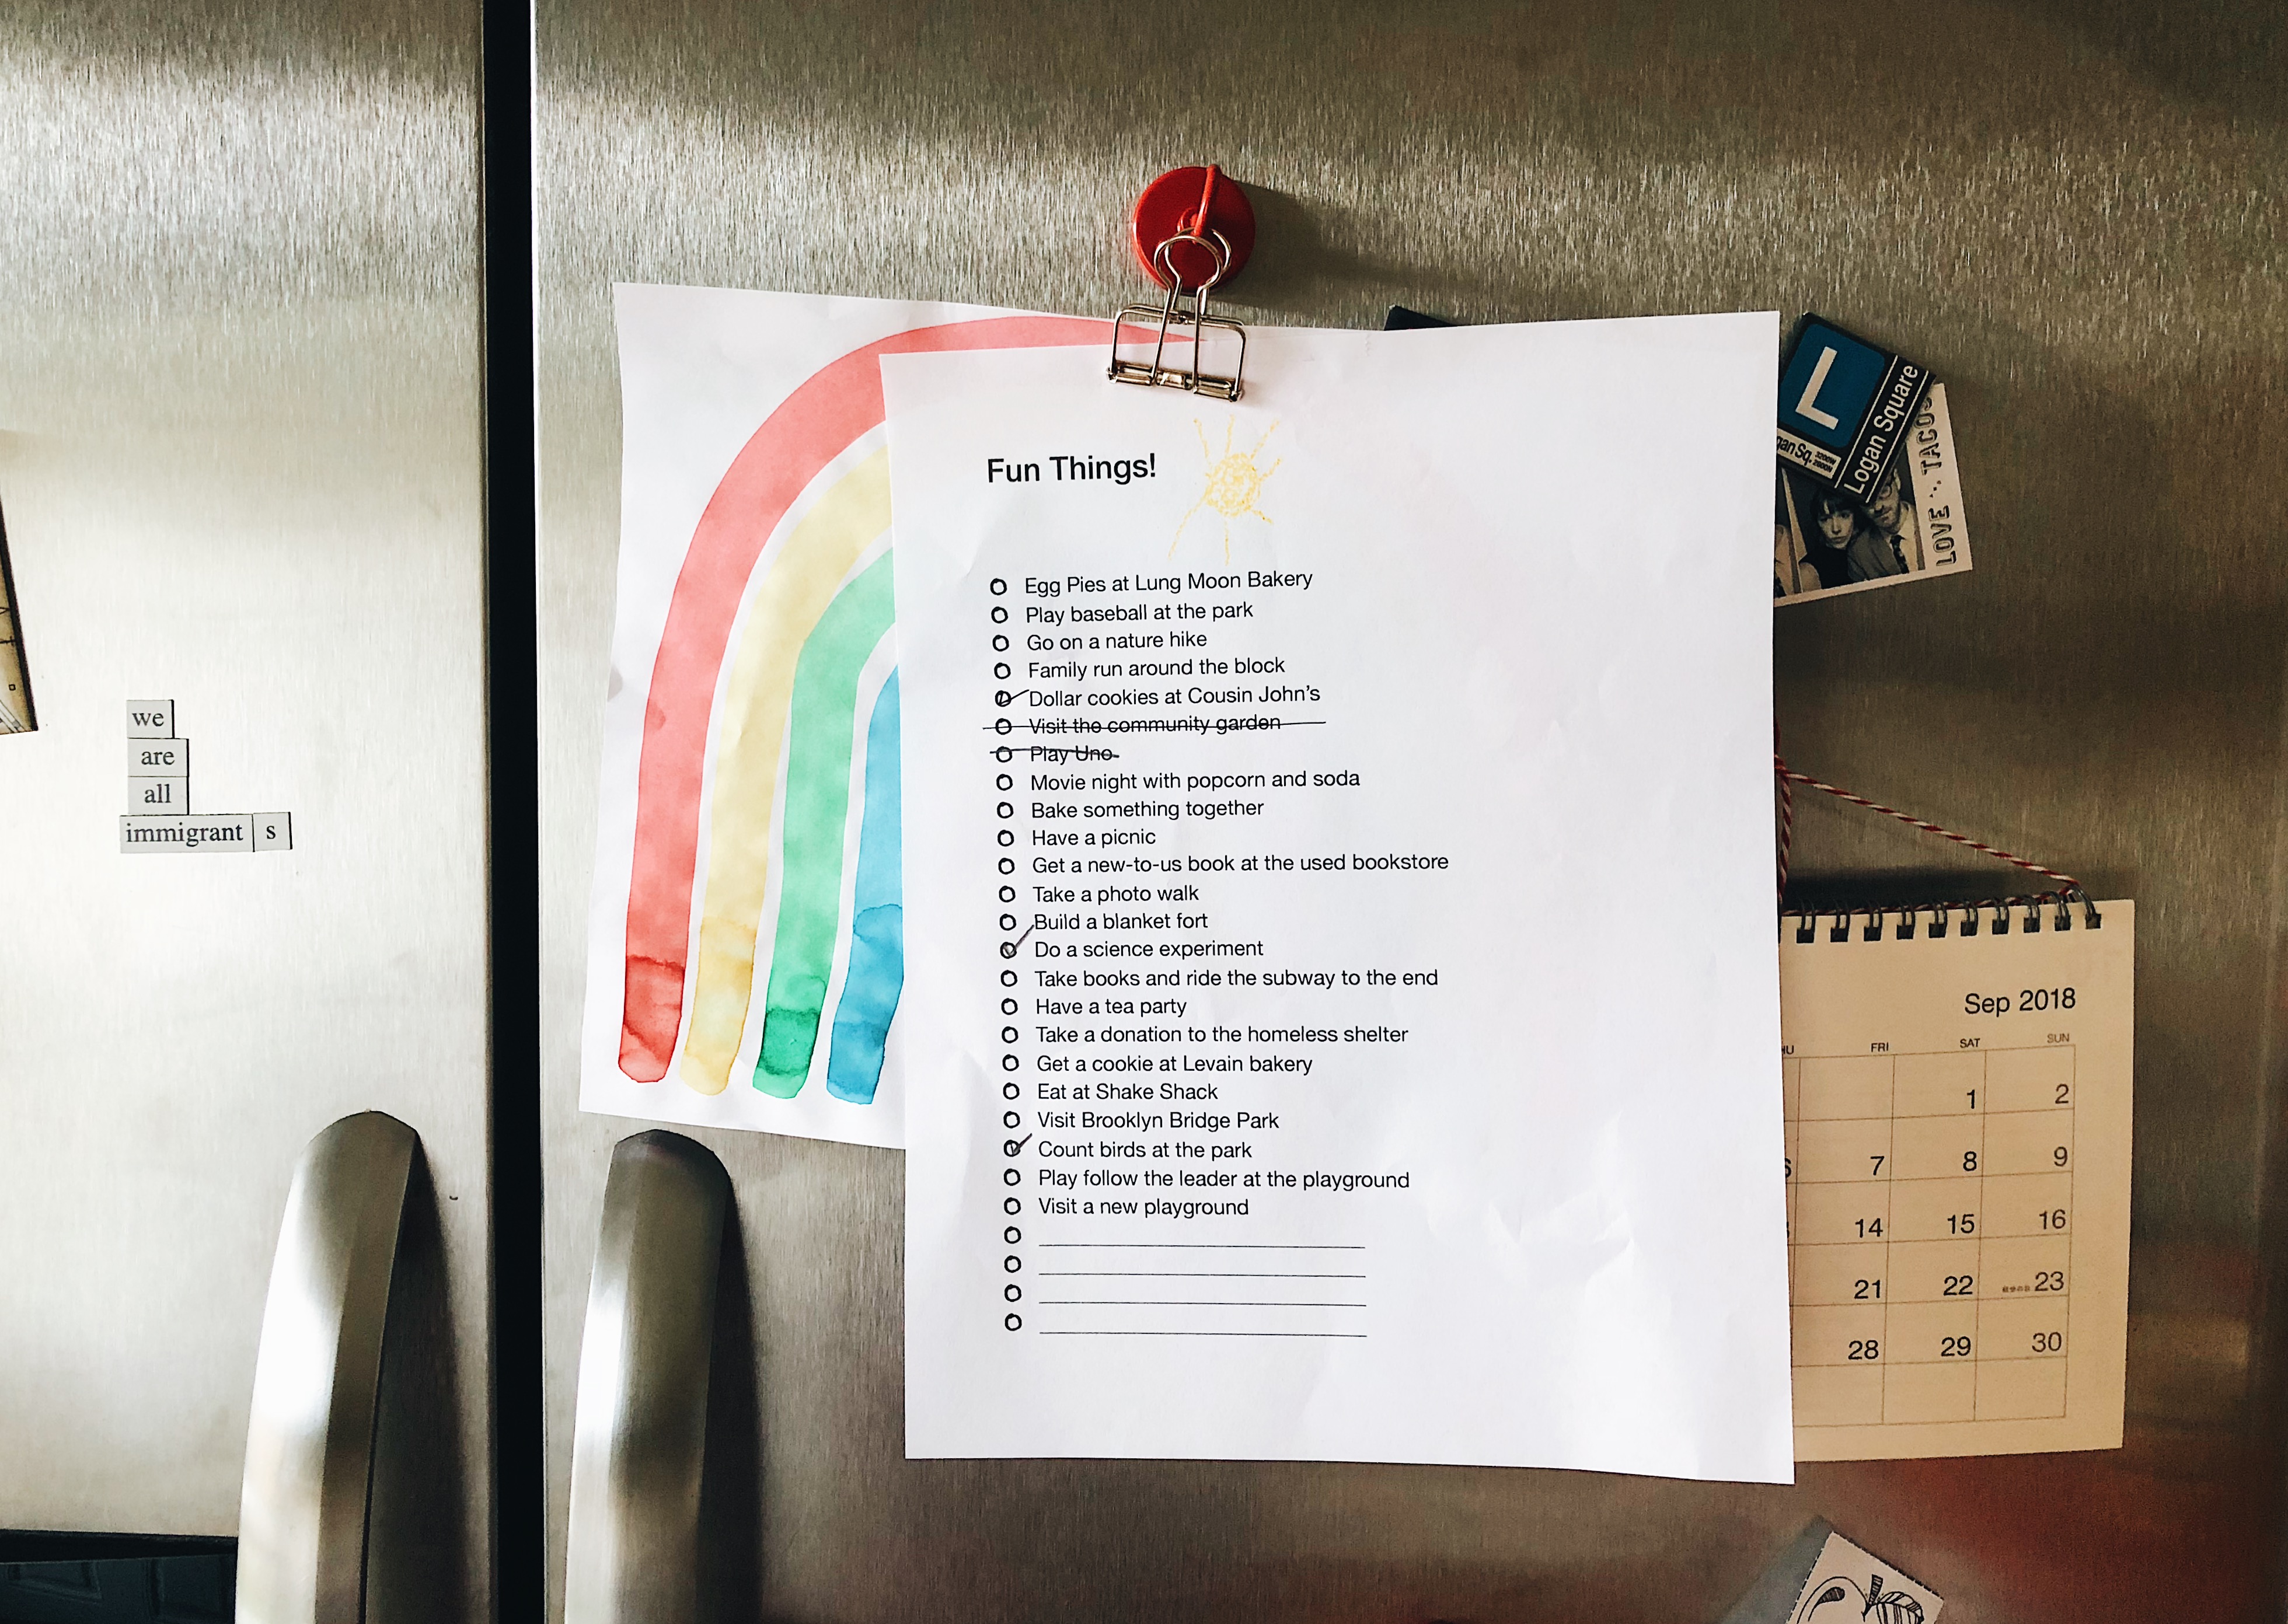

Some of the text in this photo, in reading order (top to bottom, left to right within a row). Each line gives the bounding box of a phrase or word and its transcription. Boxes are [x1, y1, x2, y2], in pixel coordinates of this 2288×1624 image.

[1795, 346, 1839, 430] L
[1843, 365, 1919, 494] Logan Square
[1777, 436, 1812, 466] gan Sq.
[988, 452, 1156, 485] Fun Things!
[1927, 505, 1957, 567] LOVE
[1026, 570, 1313, 598] Egg Pies at Lung Moon Bakery
[1026, 601, 1254, 627] Play baseball at the park
[1027, 630, 1207, 651] Go on a nature hike
[1029, 656, 1285, 682] Family run around the block
[1030, 684, 1320, 707] Dollar cookies at Cousin John’s
[132, 713, 164, 727] we
[1030, 714, 1282, 734] Visit the community garden
[141, 751, 175, 766] are
[1030, 745, 1112, 765] Play Uno
[1031, 769, 1361, 794] Movie night with popcorn and soda
[144, 783, 171, 804] all
[1032, 799, 1264, 820] Bake something together
[126, 822, 276, 847] immigrant s
[1033, 828, 1156, 849] Have a picnic
[1033, 853, 1449, 874] Get a new-to-us book at the used bookstore
[1032, 885, 1199, 906] Take a photo walk
[1034, 912, 1208, 930] Build a blanket fort
[1035, 940, 1264, 961] Do a science experiment
[1034, 969, 1438, 990] Take books and ride the subway to the end
[1036, 998, 1187, 1018] Have a tea party
[1965, 987, 2076, 1018] Sep 2018
[1035, 1025, 1409, 1043] Take a donation to the homeless shelter
[1781, 1032, 2070, 1055] HU FRI SAT SUN
[1037, 1054, 1313, 1076] Get a cookie at Levain bakery
[1038, 1082, 1218, 1100] Eat at Shake Shack
[1966, 1084, 2069, 1109] 1 2
[1037, 1111, 1279, 1133] Visit Brooklyn Bridge Park
[1038, 1140, 1252, 1162] Count birds at the park
[1870, 1155, 1885, 1176] 7
[1963, 1151, 1977, 1172] 8
[2054, 1146, 2068, 1167] 9
[1040, 1169, 1410, 1192] Play follow the leader at the playground
[1038, 1197, 1248, 1219] Visit a new playground
[1855, 1209, 2066, 1238] 14 15 16
[1854, 1271, 2064, 1300] 21 22 23
[1848, 1332, 2062, 1360] 28 29 30
